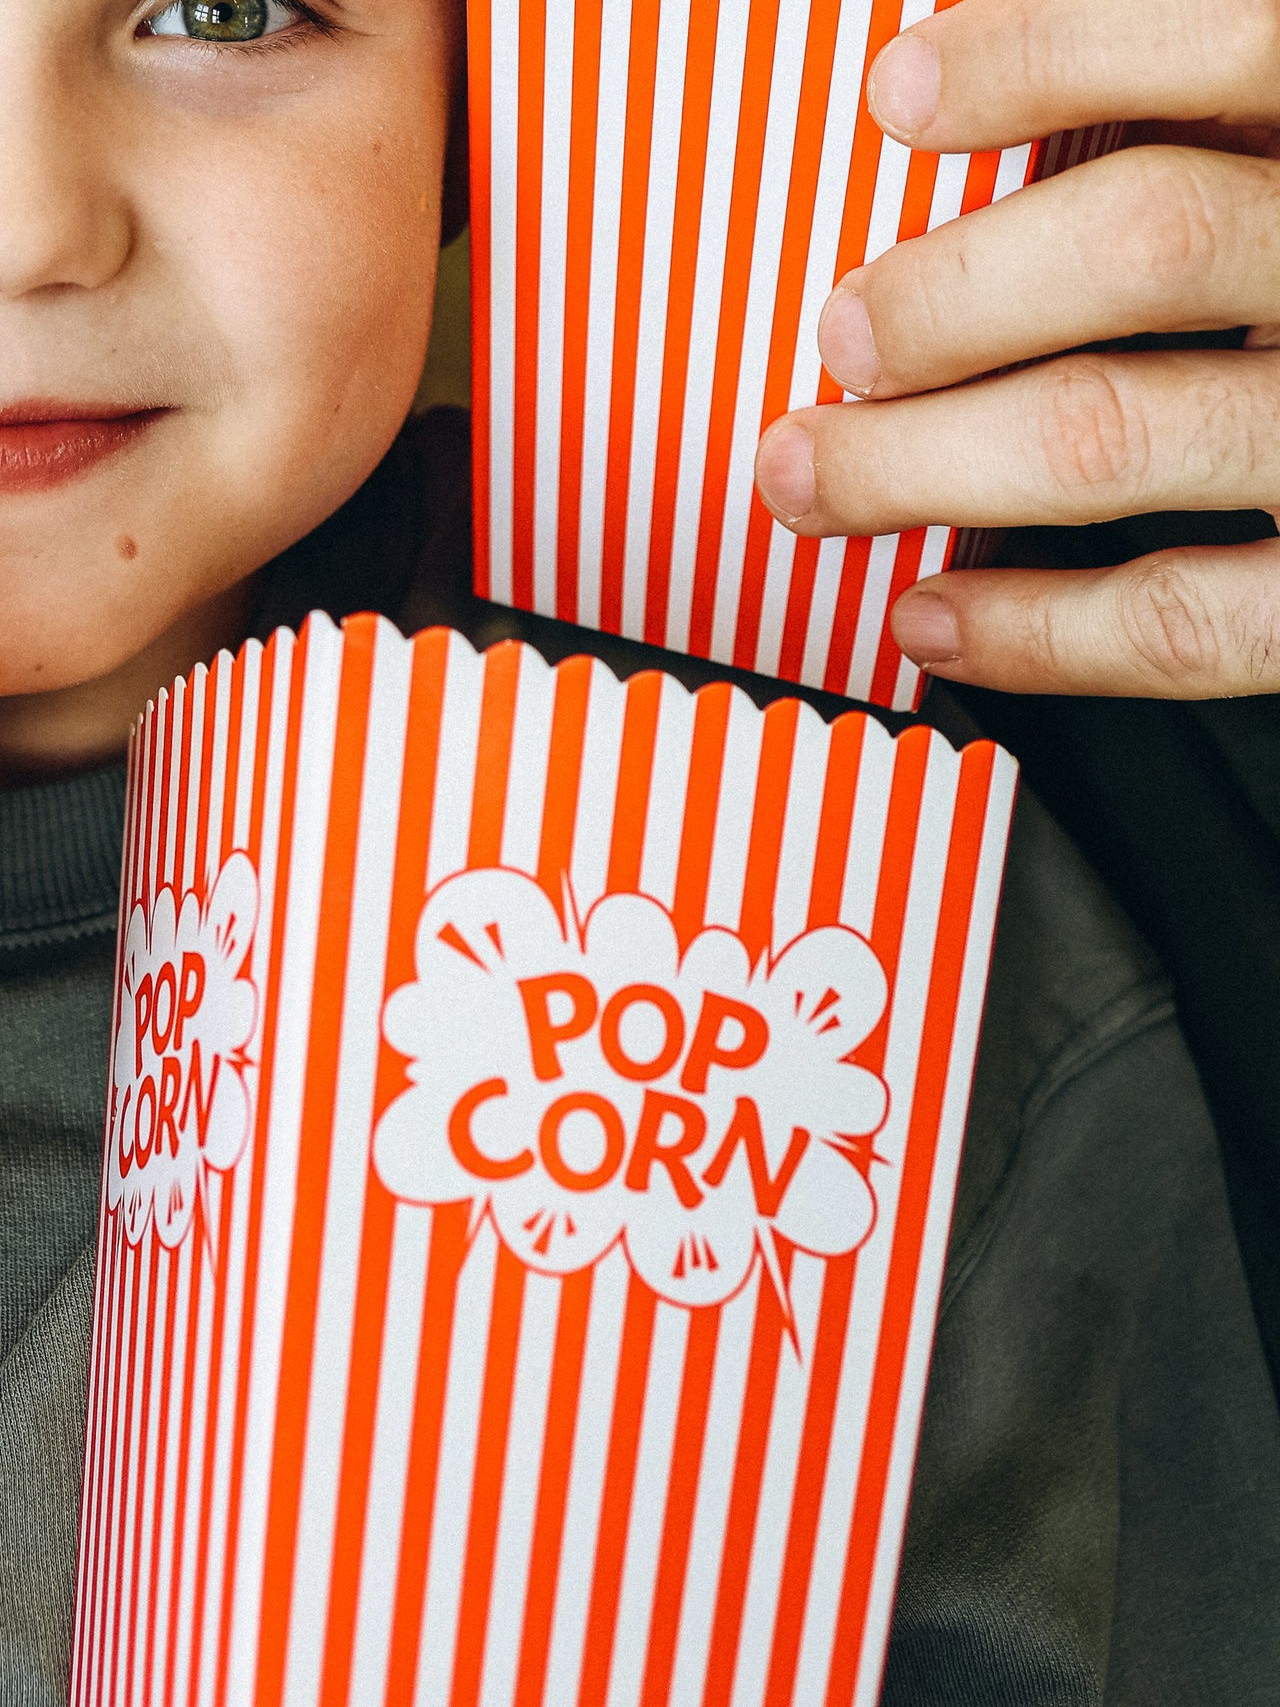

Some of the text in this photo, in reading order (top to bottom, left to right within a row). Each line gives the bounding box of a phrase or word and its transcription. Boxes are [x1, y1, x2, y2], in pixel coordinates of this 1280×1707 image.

[135, 951, 206, 1079] POP
[516, 971, 770, 1094] POP
[119, 1038, 220, 1179] CORN
[447, 1077, 811, 1219] CORN
